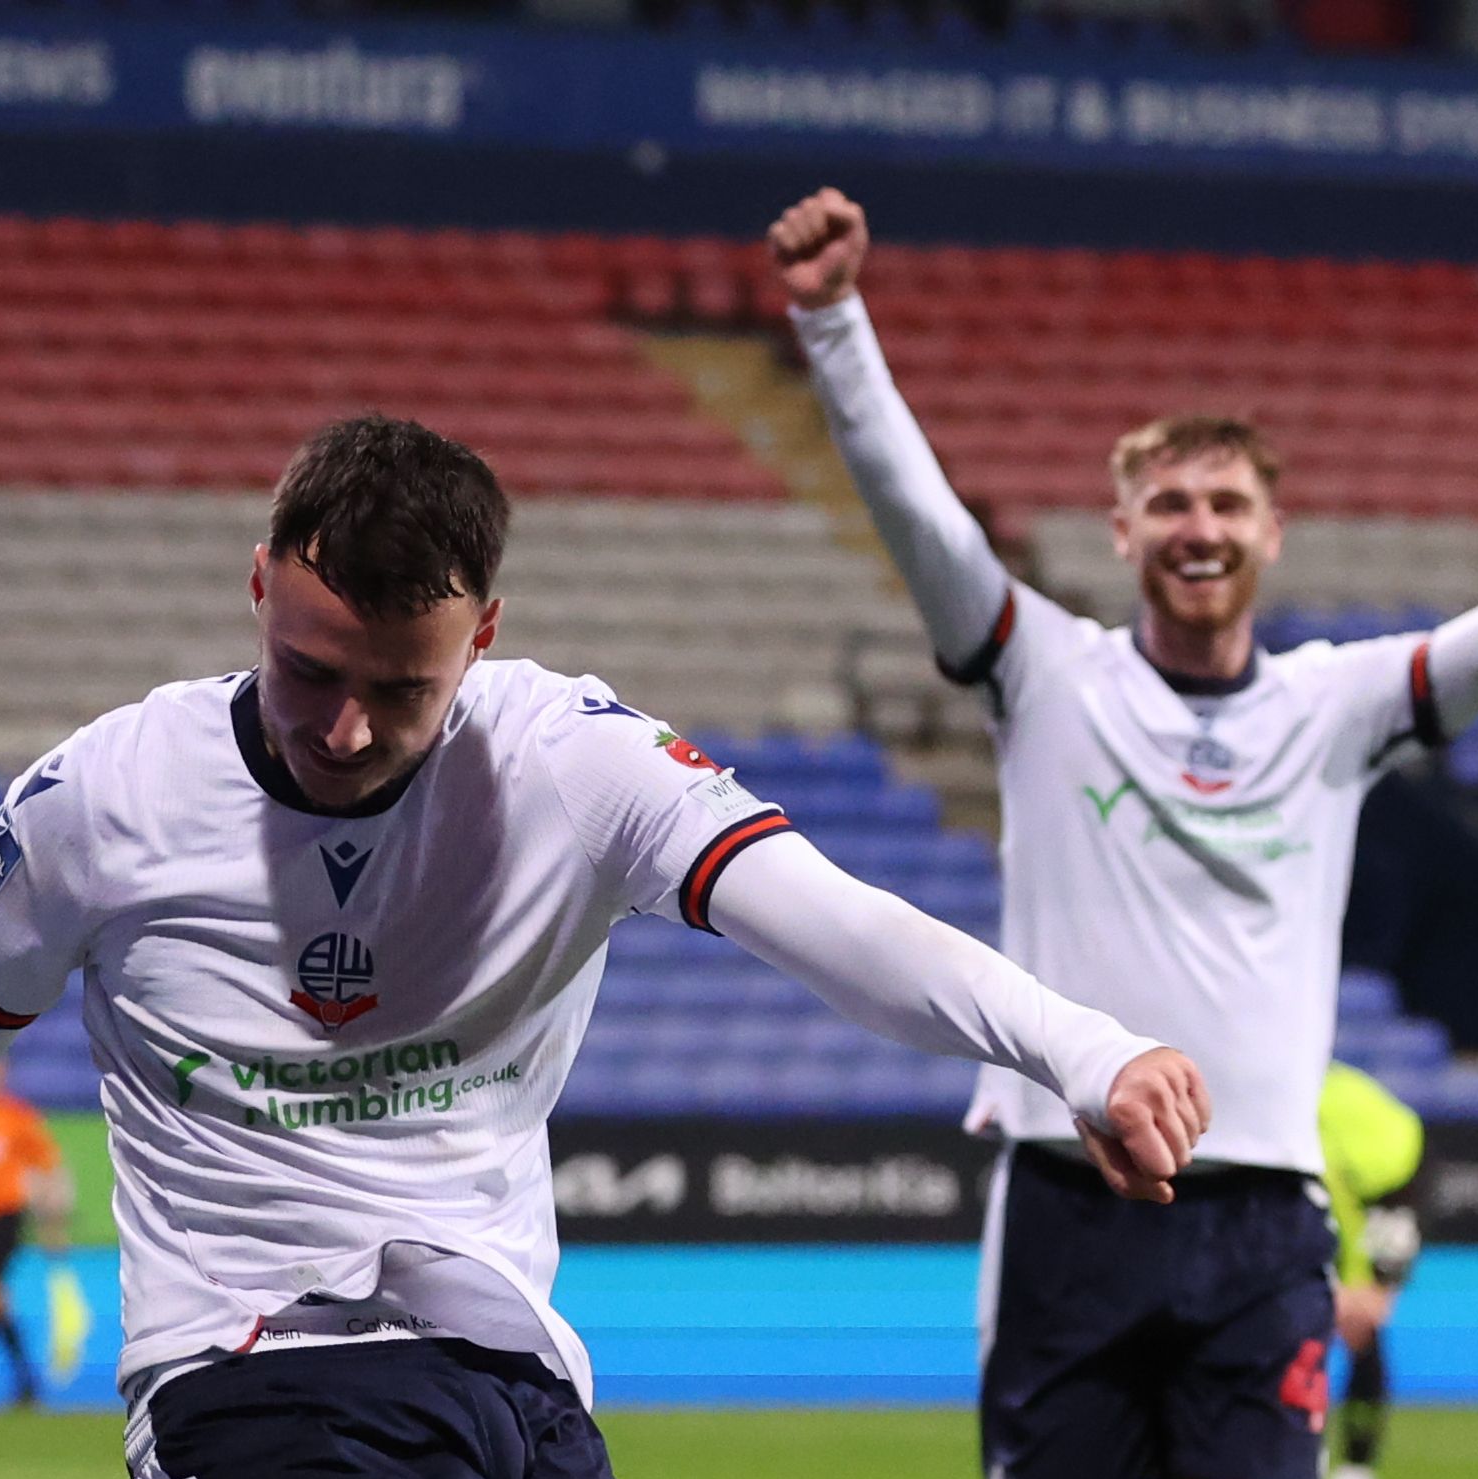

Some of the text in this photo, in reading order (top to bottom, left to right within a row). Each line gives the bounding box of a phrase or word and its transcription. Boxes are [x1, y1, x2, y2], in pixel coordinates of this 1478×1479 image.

[698, 67, 992, 138] MANAGED
[1004, 75, 1057, 138] IT
[1069, 77, 1113, 142] &
[1124, 79, 1385, 153] BUSINESS
[230, 1038, 461, 1091] victorian
